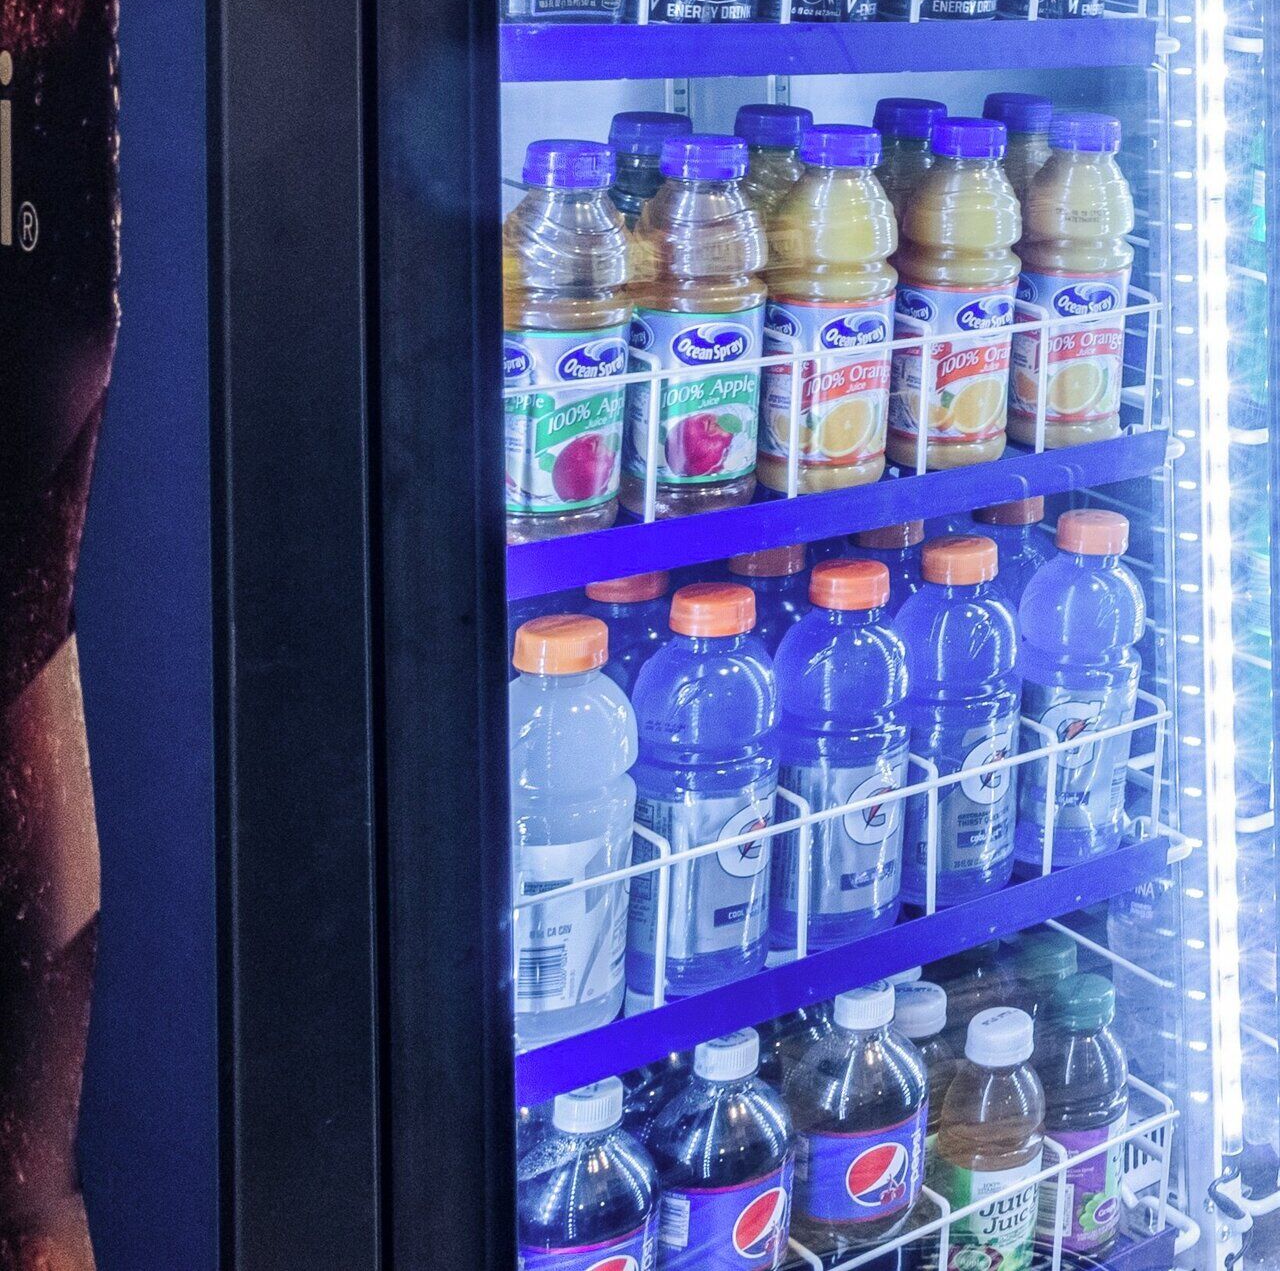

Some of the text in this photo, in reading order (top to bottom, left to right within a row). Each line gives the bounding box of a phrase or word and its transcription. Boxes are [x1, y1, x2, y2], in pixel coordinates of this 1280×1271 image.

[667, 3, 718, 18] ENERGY
[933, 0, 976, 14] ENERGY
[1058, 295, 1112, 315] Ocean Spray
[961, 310, 991, 329] Ocean
[825, 325, 884, 347] Ocean Spray
[1080, 332, 1122, 350] Orange
[677, 337, 743, 362] Ocean Spray
[564, 353, 624, 378] Ocean Spray
[940, 349, 979, 377] 100%
[662, 375, 755, 408] 100% Apple
[806, 369, 846, 397] 100%
[515, 395, 545, 410] pple
[548, 401, 592, 435] 100%
